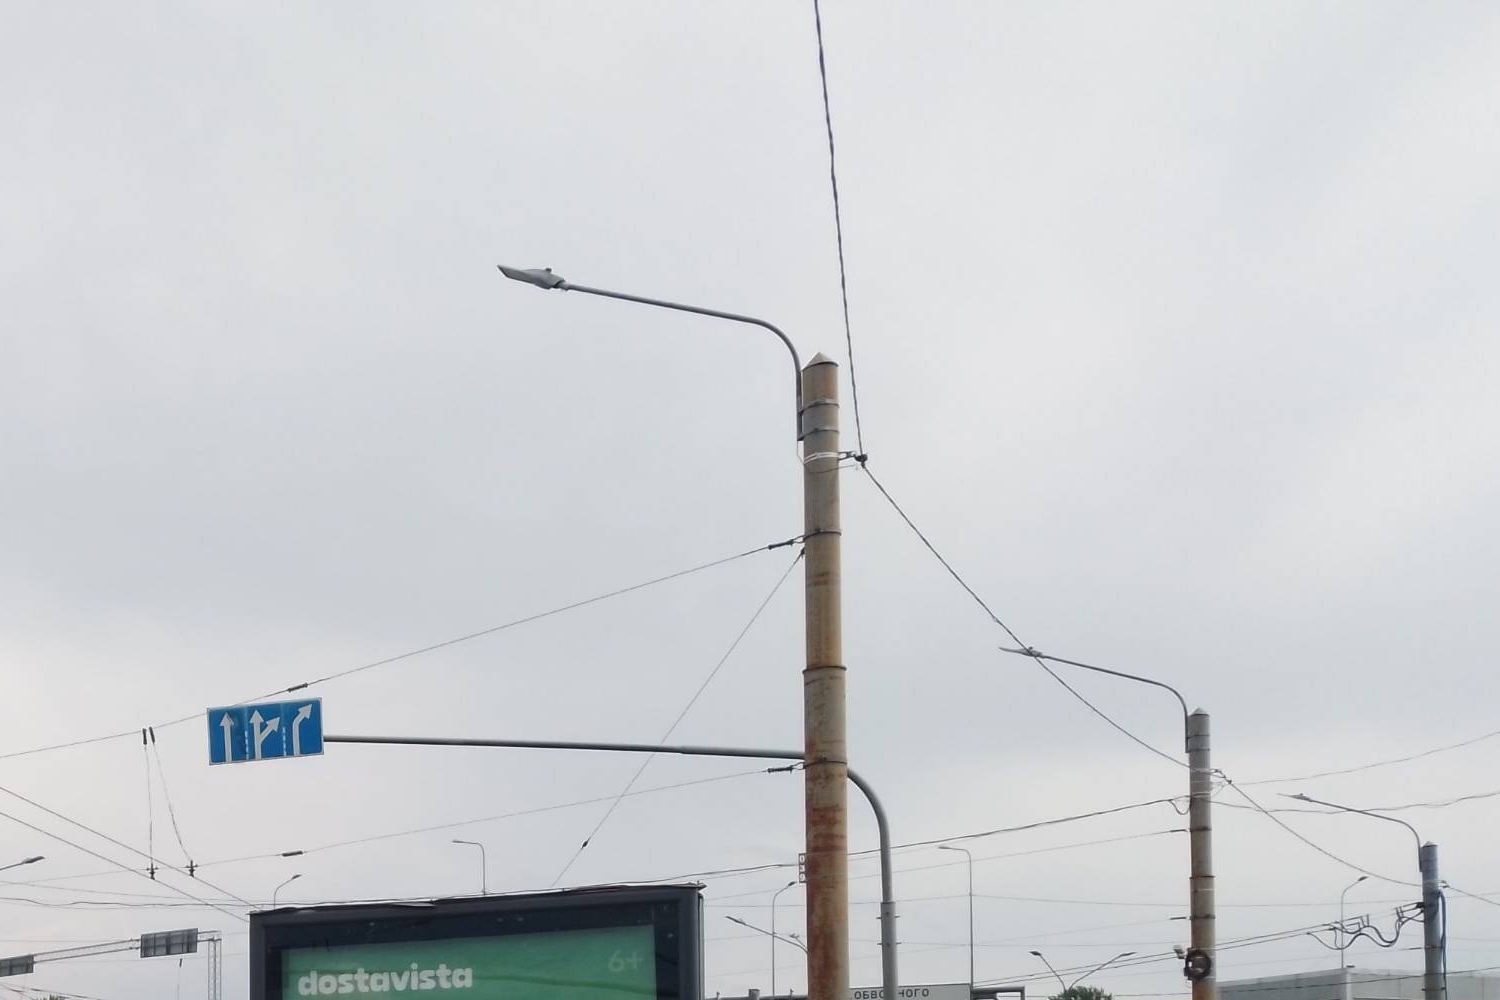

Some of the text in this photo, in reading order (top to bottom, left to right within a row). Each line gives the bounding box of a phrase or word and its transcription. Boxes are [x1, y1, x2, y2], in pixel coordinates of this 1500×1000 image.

[608, 950, 644, 972] 6+
[298, 963, 473, 996] dostavista
[854, 988, 930, 1000] ОБВОНОГО
